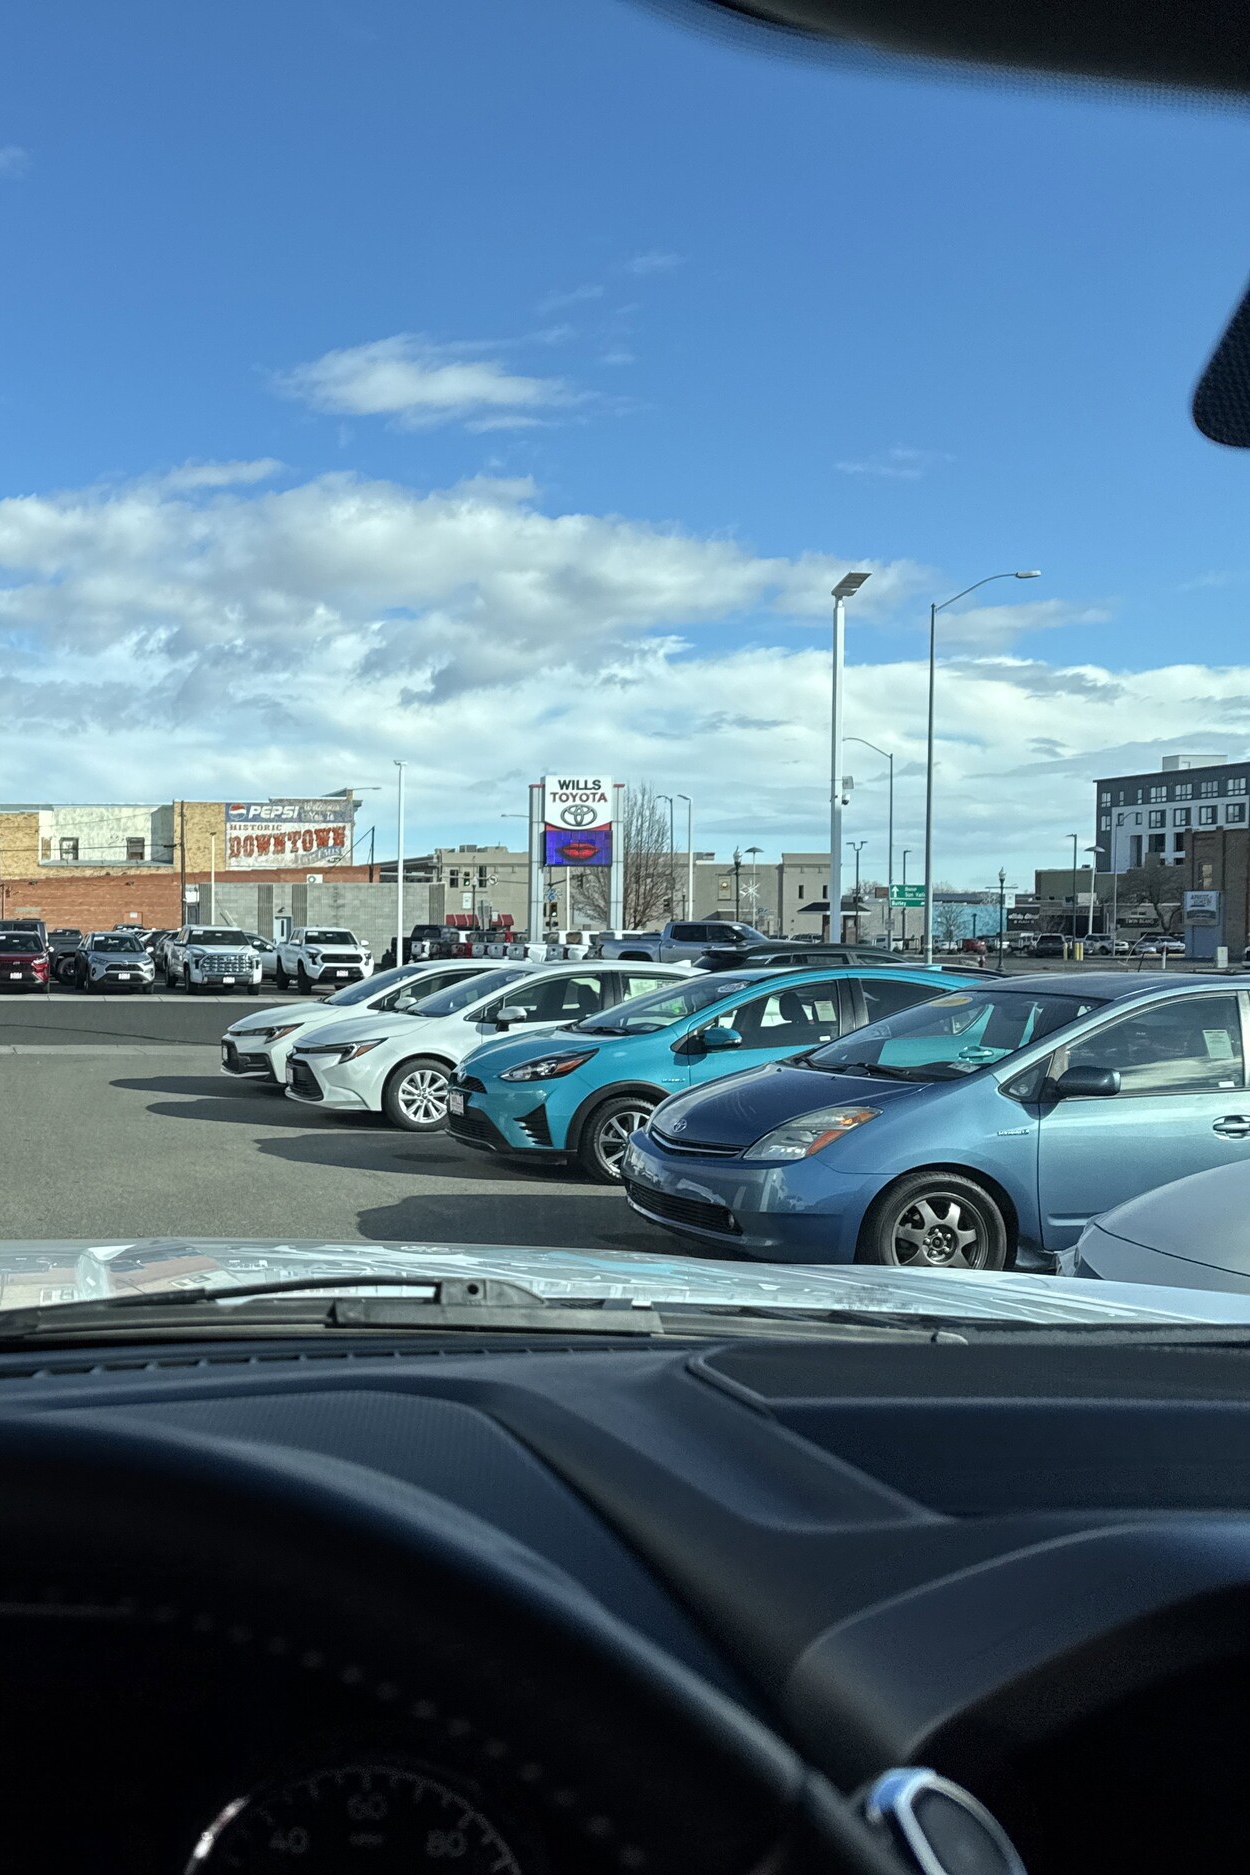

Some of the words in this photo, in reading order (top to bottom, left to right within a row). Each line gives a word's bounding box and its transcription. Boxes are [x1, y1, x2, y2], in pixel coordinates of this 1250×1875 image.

[549, 792, 608, 803] TOYOTA
[557, 779, 601, 791] WILLS
[248, 805, 300, 819] PEPSI
[228, 825, 347, 859] DOWNTOWN
[346, 1792, 389, 1822] 60
[268, 1824, 311, 1855] 40
[425, 1827, 468, 1858] 80
